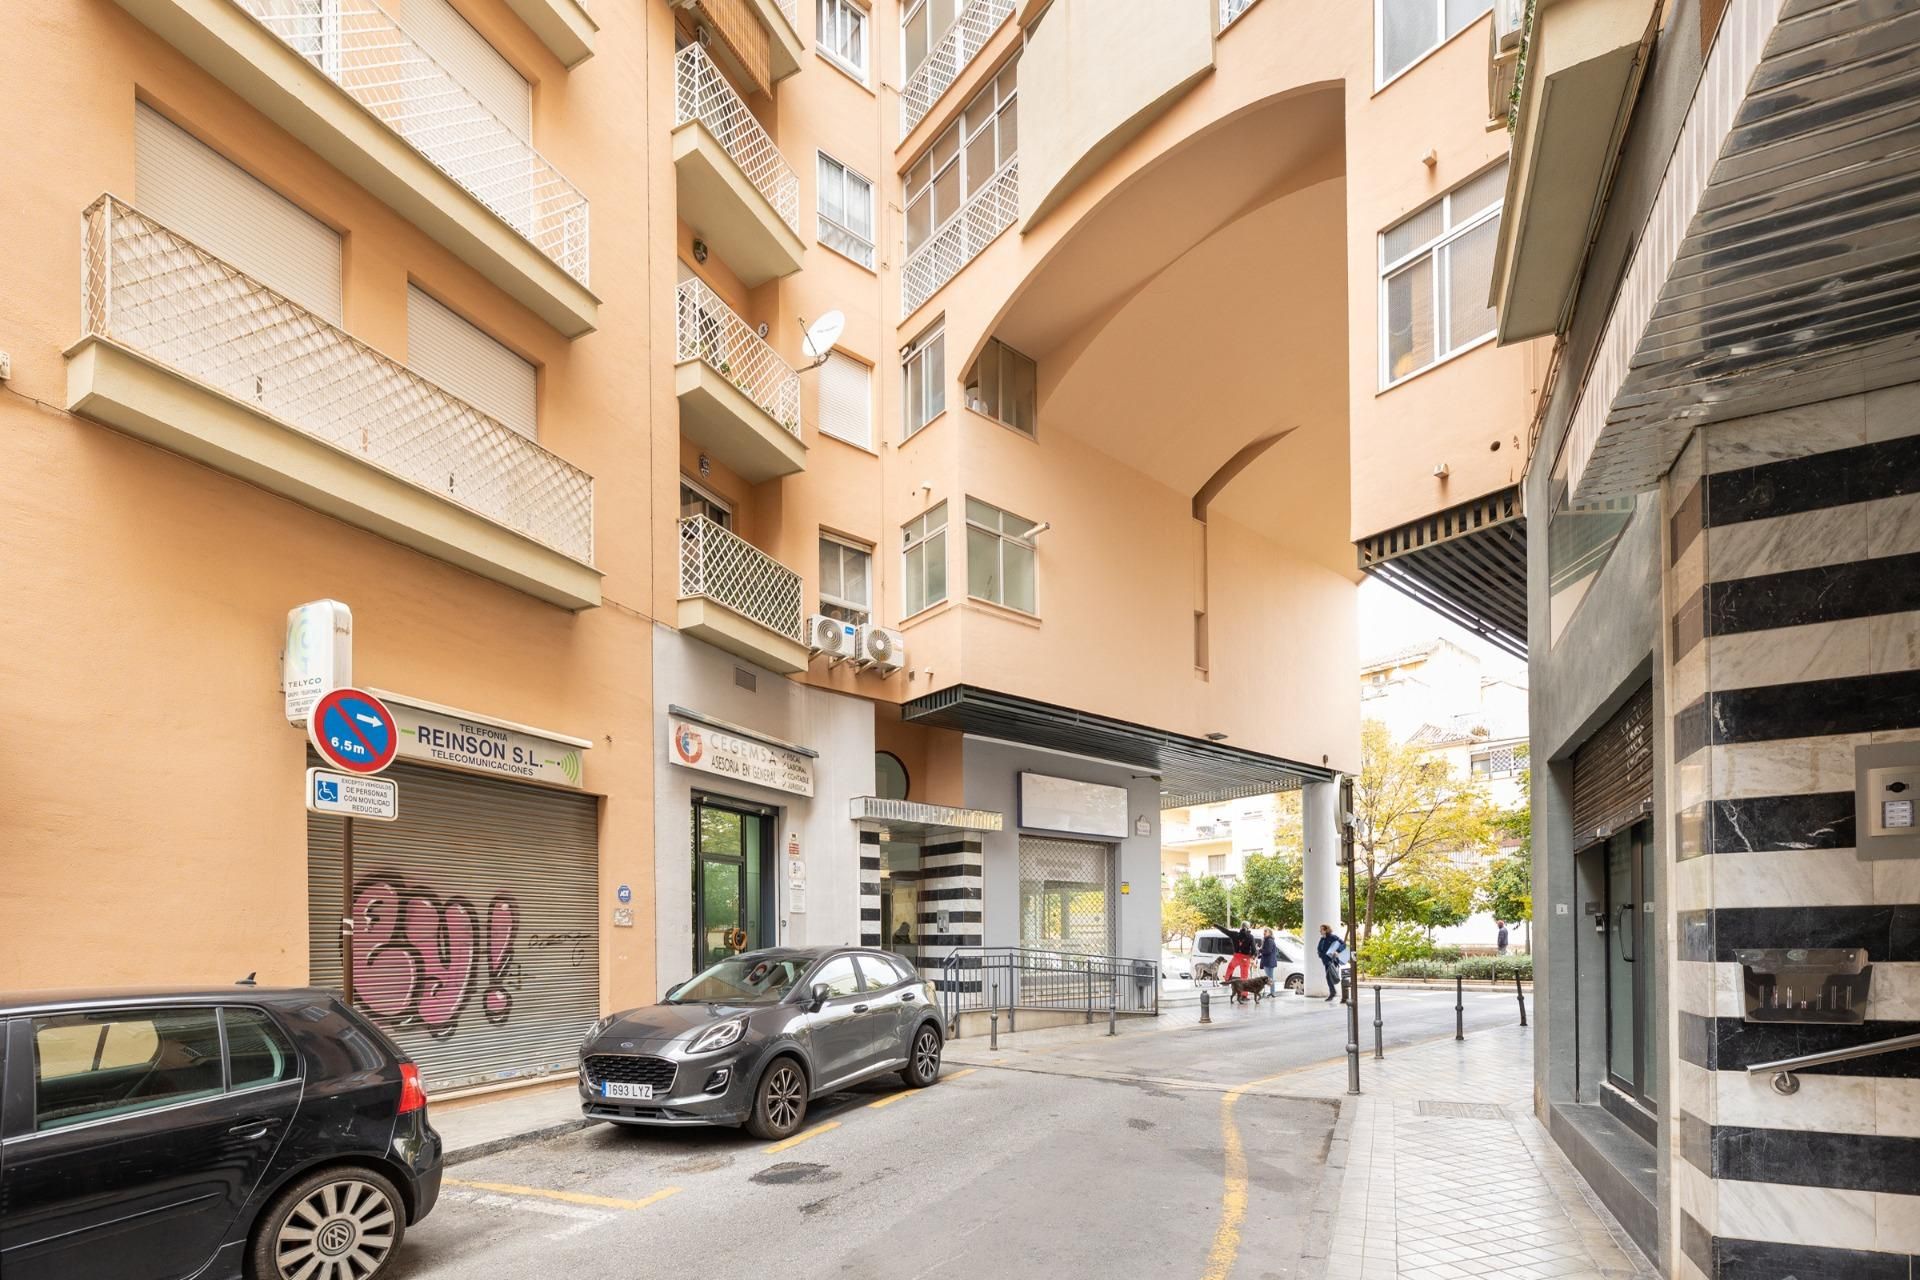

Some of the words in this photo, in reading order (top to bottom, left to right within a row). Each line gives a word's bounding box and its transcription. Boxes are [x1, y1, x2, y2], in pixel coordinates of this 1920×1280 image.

[287, 677, 322, 689] TELYCO
[459, 723, 508, 742] TELEFONIA
[330, 736, 365, 755] 6,5m
[418, 726, 505, 760] REINSON
[512, 747, 543, 768] S.L.
[710, 733, 778, 766] CEGEMSA
[431, 749, 534, 776] TELECOMUNICACIONES
[711, 755, 740, 774] ASESORIA
[742, 762, 750, 777] EN
[753, 766, 777, 784] GENERAL
[341, 778, 365, 787] EXCEPTO
[345, 786, 354, 794] DE
[356, 788, 388, 798] PERSONAS
[343, 795, 357, 803] CON
[358, 797, 390, 807] MOVILIDAD
[352, 804, 383, 814] REDUCIDA
[608, 1084, 629, 1096] 1693
[632, 1085, 651, 1098] LYZ
